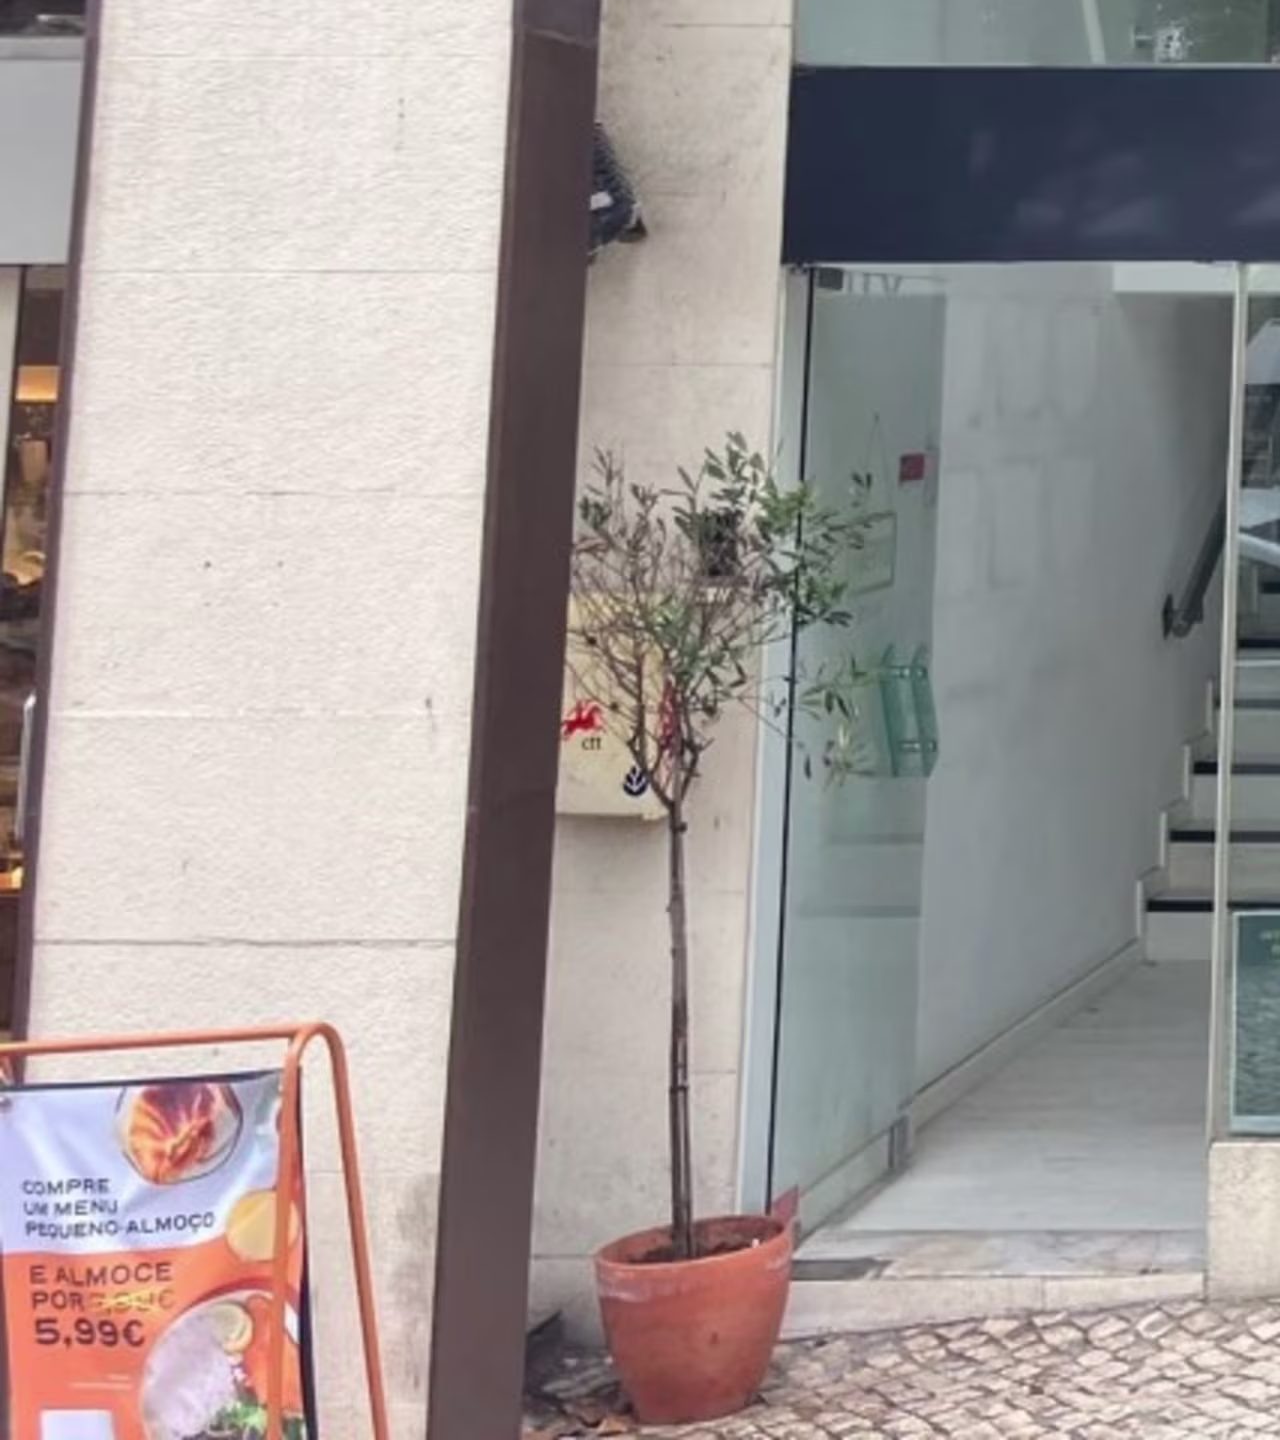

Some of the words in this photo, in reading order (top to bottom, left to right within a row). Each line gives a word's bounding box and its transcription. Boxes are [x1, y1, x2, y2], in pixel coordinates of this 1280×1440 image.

[22, 1178, 110, 1196] COMPRE
[23, 1200, 49, 1216] UM
[53, 1199, 119, 1216] MENU
[30, 1264, 48, 1285] E
[55, 1262, 173, 1287] ALMOCE
[32, 1289, 85, 1312] POR
[34, 1318, 146, 1349] 5,99€
